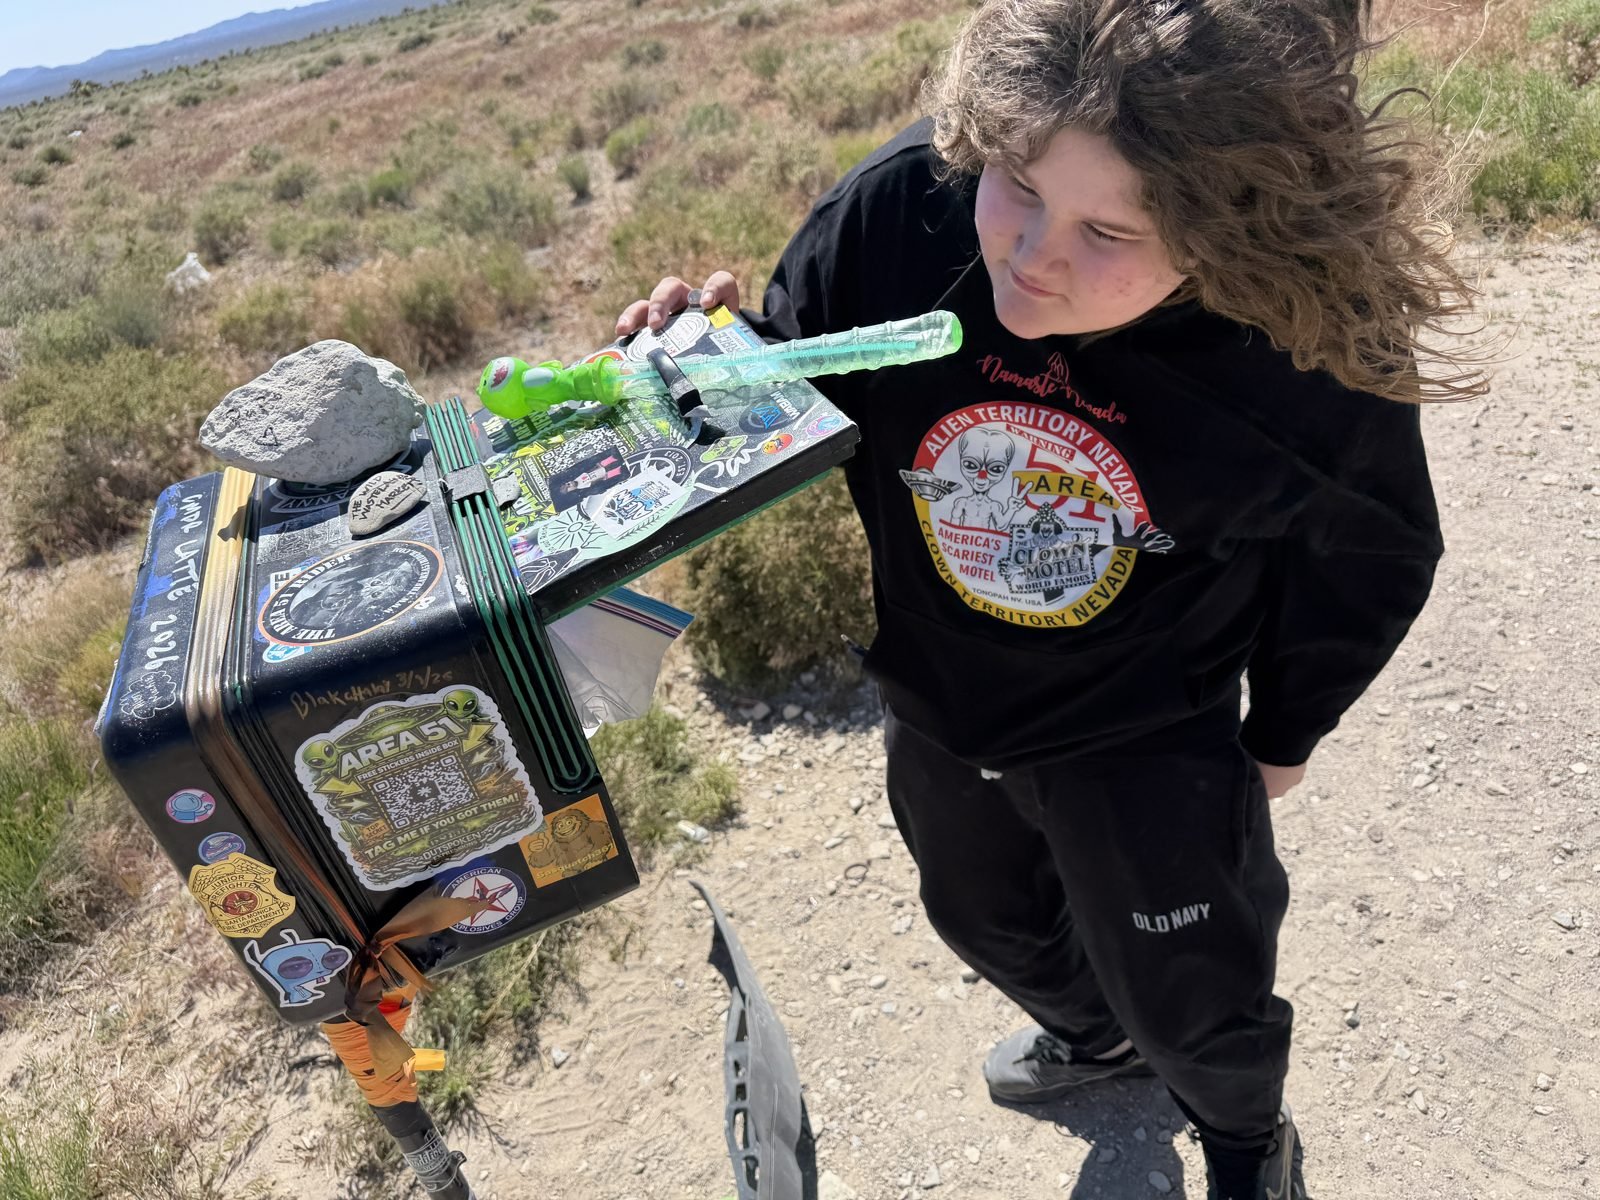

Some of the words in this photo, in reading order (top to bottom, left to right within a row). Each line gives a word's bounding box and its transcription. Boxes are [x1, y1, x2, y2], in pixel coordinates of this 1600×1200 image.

[976, 355, 1057, 398] Namaste
[770, 391, 801, 420] WABAM
[482, 415, 511, 446] ALIENS
[1009, 426, 1074, 459] WARNING
[664, 450, 684, 462] 2013
[925, 412, 974, 457] ALIEN
[974, 405, 1093, 446] TERRITORY
[1088, 441, 1145, 513] NEVADA
[352, 499, 362, 520] THE
[359, 475, 384, 496] WILD
[1034, 474, 1115, 507] AREA
[181, 493, 203, 534] CMDR
[937, 529, 1001, 551] AMERICA'S
[941, 542, 995, 566] SCARIEST
[167, 538, 200, 602] LATTE
[289, 553, 353, 590] RIDER
[921, 520, 958, 587] CLOWN
[960, 590, 1068, 627] TERRITORY
[1073, 548, 1133, 623] NEVADA
[959, 563, 997, 583] MOTEL
[1016, 580, 1052, 591] WORLD
[1054, 574, 1091, 587] FAMOUS
[273, 592, 295, 607] 51
[972, 587, 1009, 601] TONOPAH
[1024, 598, 1043, 607] USA
[270, 609, 293, 636] AREA
[291, 627, 336, 640] THE
[144, 613, 179, 670] 2026
[340, 730, 423, 778] AREA
[420, 716, 465, 741] 51
[357, 769, 378, 781] FREE
[378, 755, 416, 774] STICKERS
[416, 745, 442, 759] INSIDE
[442, 739, 459, 750] BOX
[364, 840, 396, 859] TAG
[399, 831, 419, 844] ME
[420, 825, 430, 835] IF
[431, 815, 455, 830] YOU
[456, 807, 480, 820] GOT
[480, 792, 520, 812] THEM!
[366, 822, 379, 832] TOP
[422, 831, 482, 861] OUTSPOKEN
[211, 874, 245, 890] JUNIOR
[451, 868, 502, 890] AMERICAN
[222, 921, 238, 931] FIRE
[237, 909, 281, 928] DEPARTMENT
[224, 914, 249, 926] SANTA
[247, 905, 274, 918] MONICA
[453, 920, 503, 933] XPLOSIVES
[505, 896, 524, 921] GROUP
[1132, 911, 1171, 933] OLD
[1171, 903, 1211, 930] NAVY
